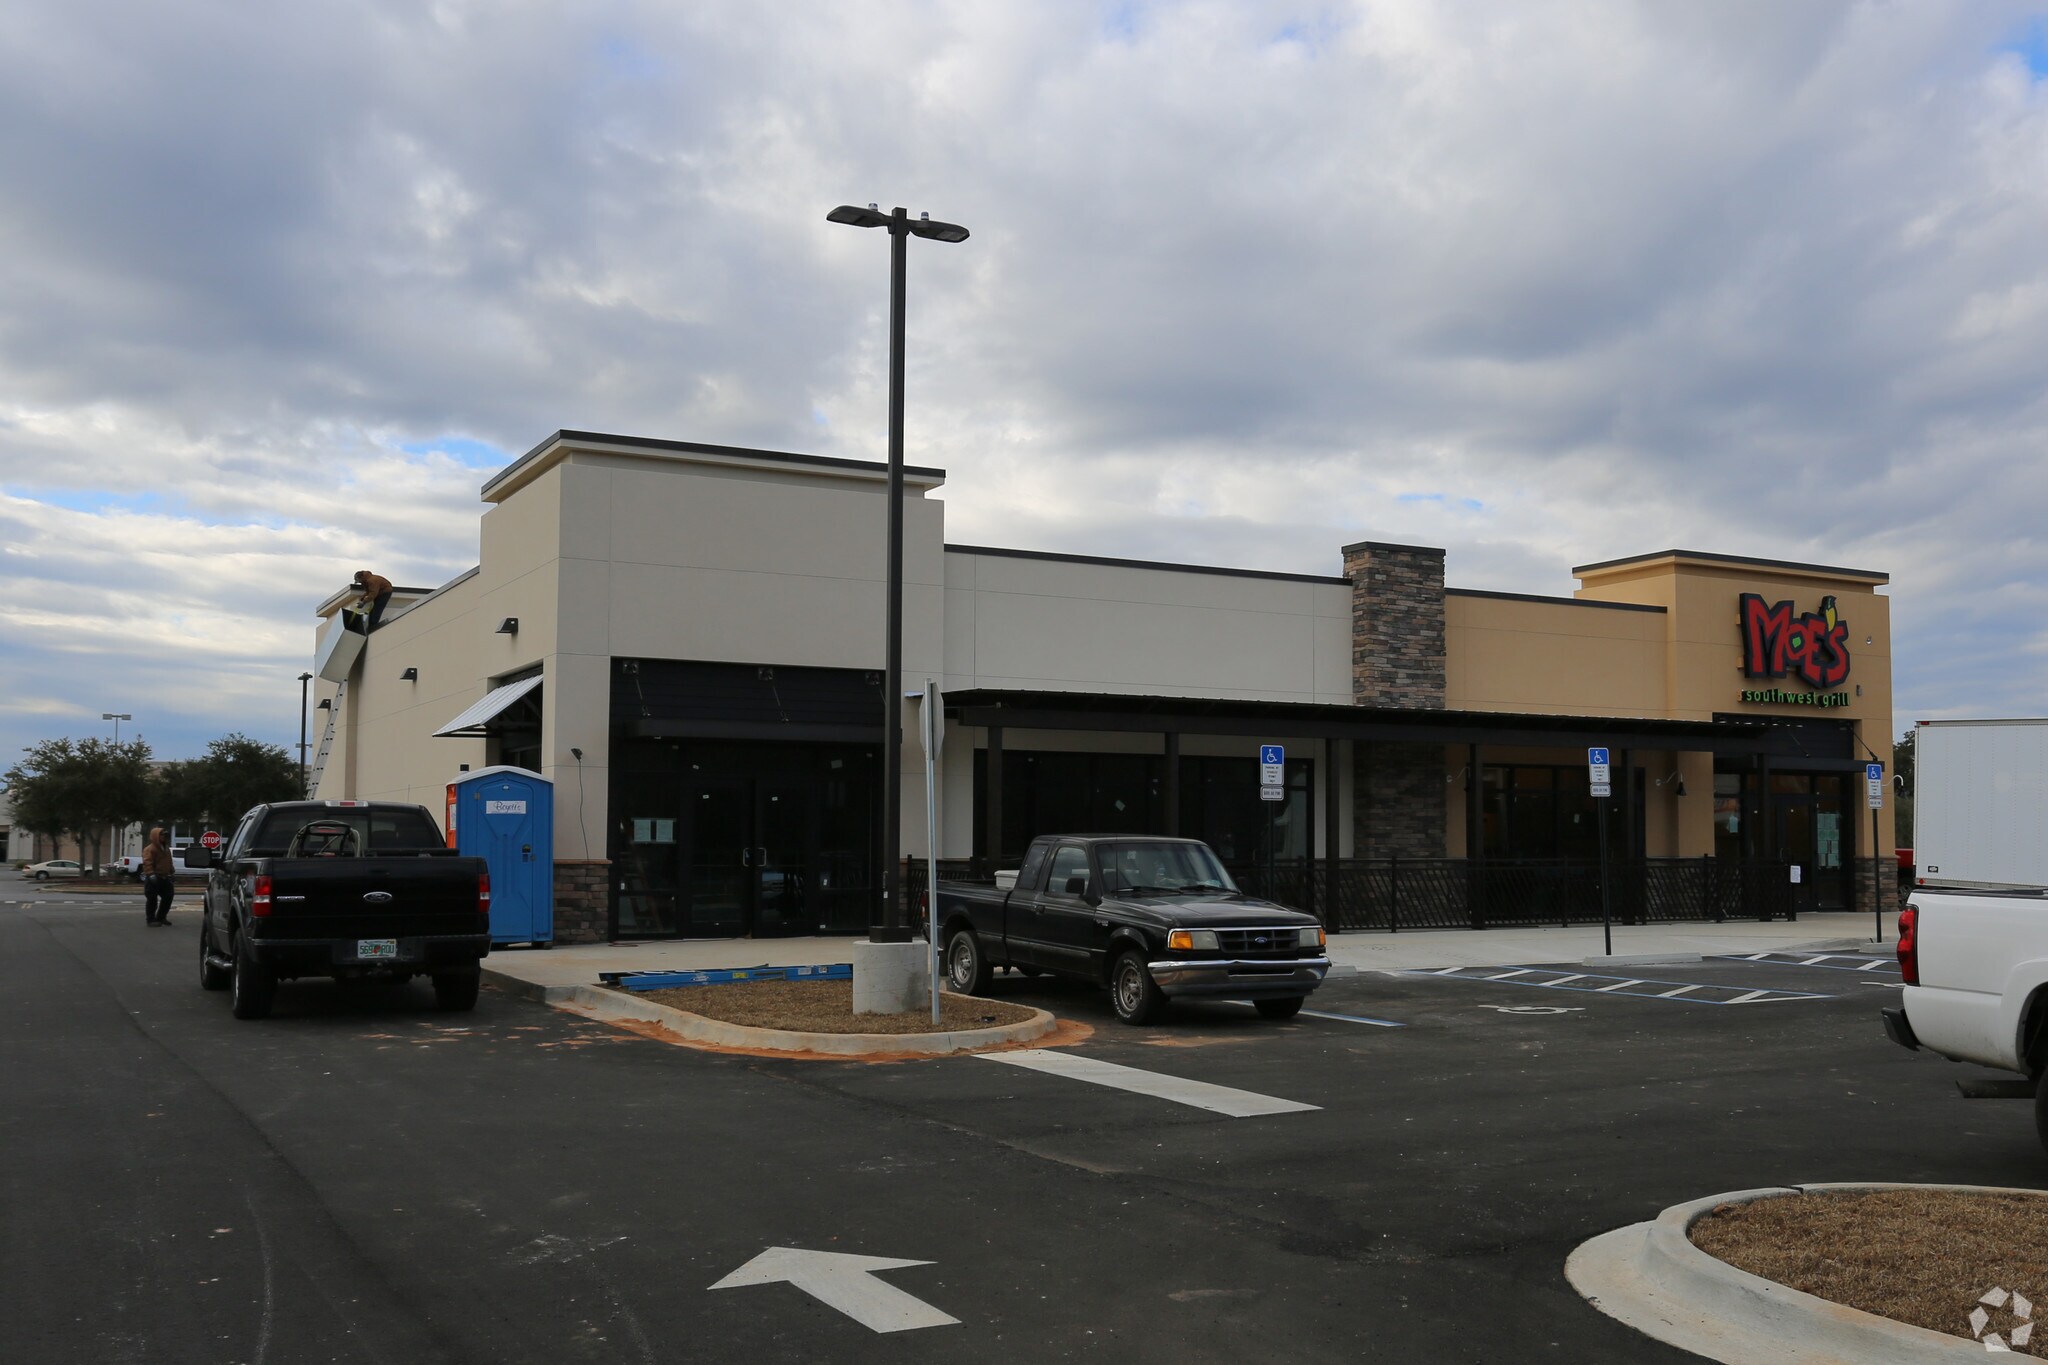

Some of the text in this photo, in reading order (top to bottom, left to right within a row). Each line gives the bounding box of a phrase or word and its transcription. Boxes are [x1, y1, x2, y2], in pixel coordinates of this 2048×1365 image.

[1744, 689, 1850, 708] southwest grill
[203, 836, 220, 844] STOP
